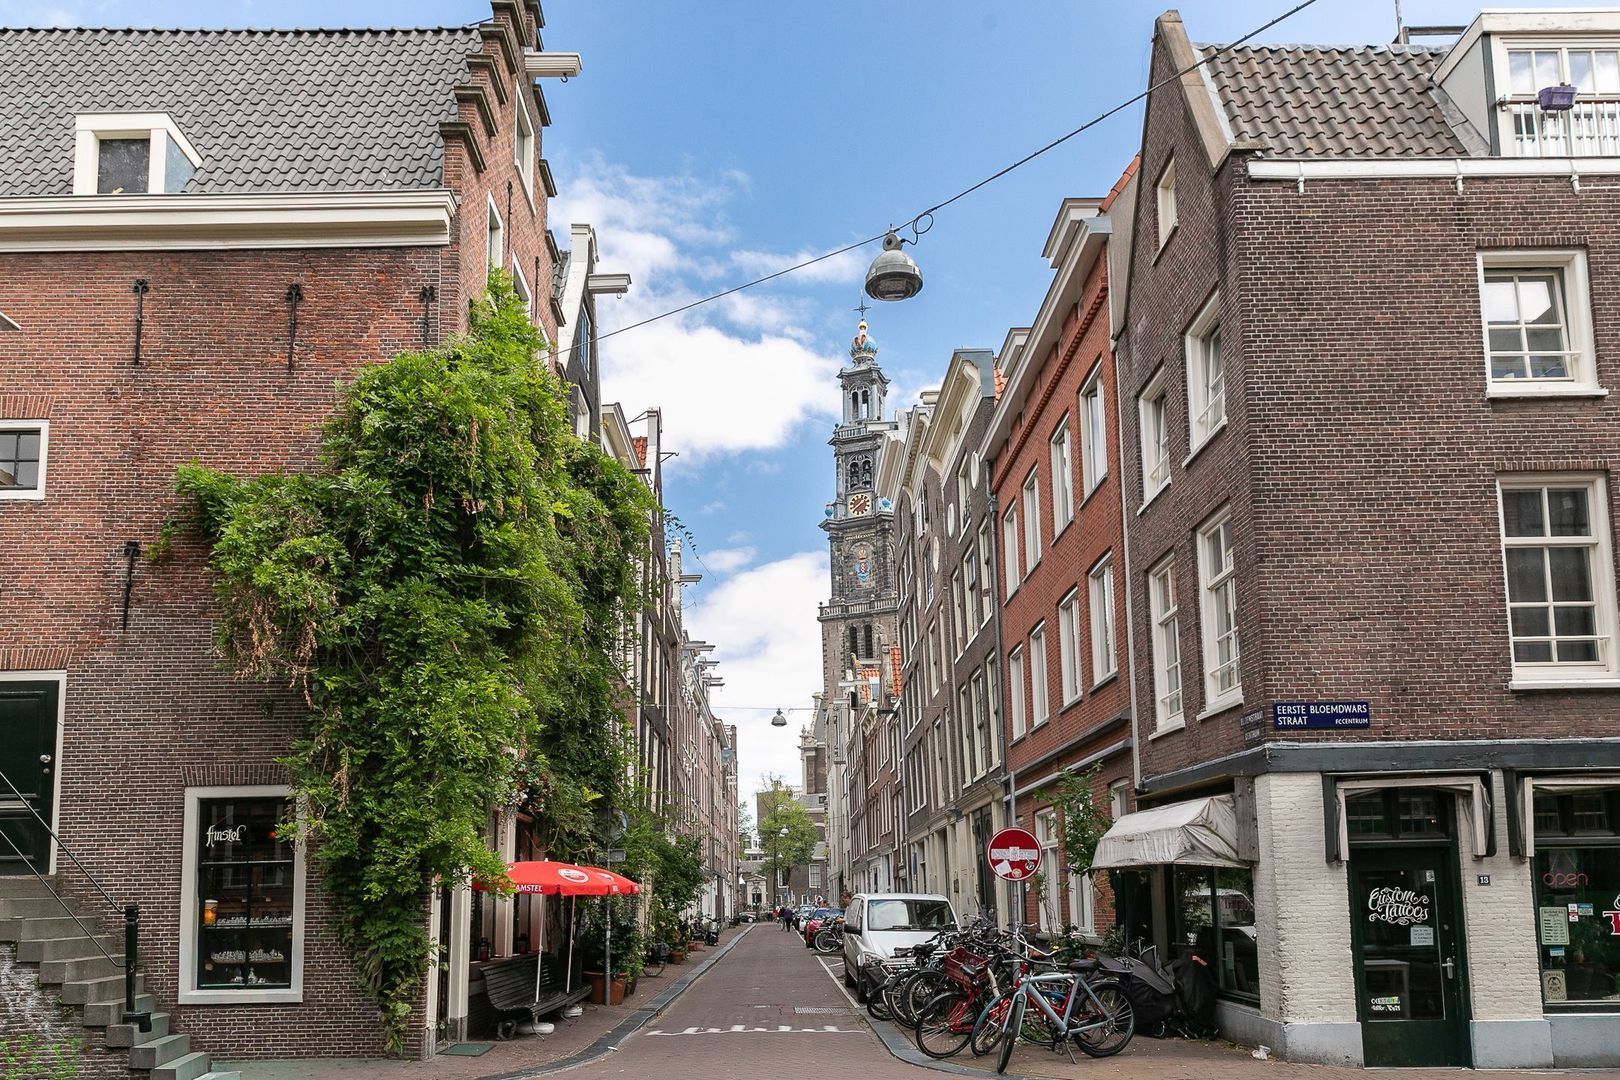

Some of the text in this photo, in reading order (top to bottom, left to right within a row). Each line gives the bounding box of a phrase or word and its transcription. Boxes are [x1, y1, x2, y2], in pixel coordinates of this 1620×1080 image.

[1277, 705, 1367, 714] EERSTE BLOEMDWARS
[1278, 716, 1308, 725] STRAAT
[1480, 876, 1489, 884] 13
[1543, 872, 1589, 888] open
[515, 884, 543, 892] AMSTEL
[1368, 887, 1429, 910] Custom
[1377, 901, 1429, 921] Tattoos
